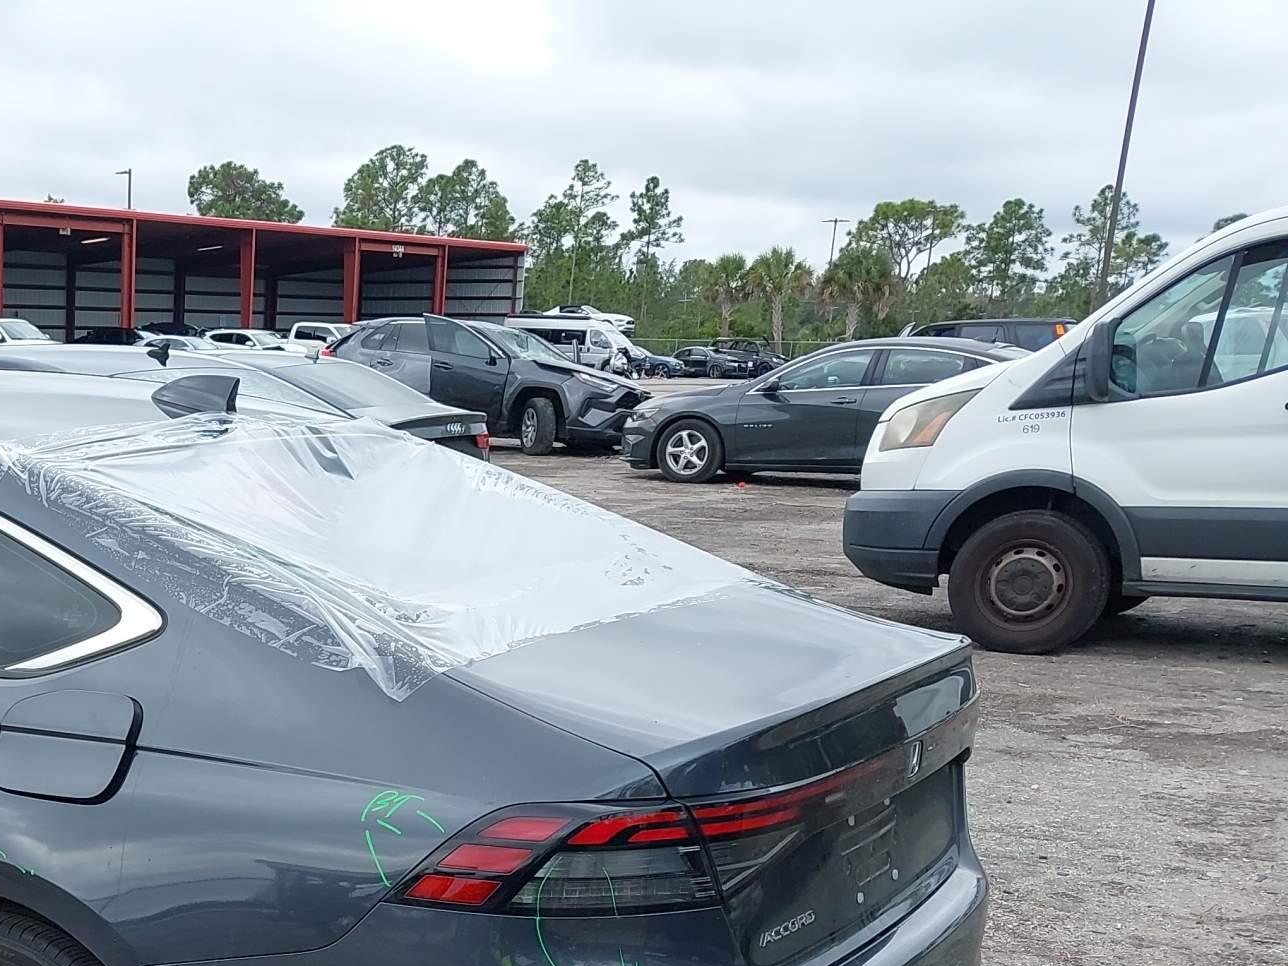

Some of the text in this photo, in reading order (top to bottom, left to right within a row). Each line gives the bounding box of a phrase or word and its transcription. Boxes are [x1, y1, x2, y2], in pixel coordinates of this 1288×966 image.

[1018, 410, 1066, 421] CFC053936
[1022, 423, 1040, 434] 619
[759, 910, 816, 947] ACCORD
